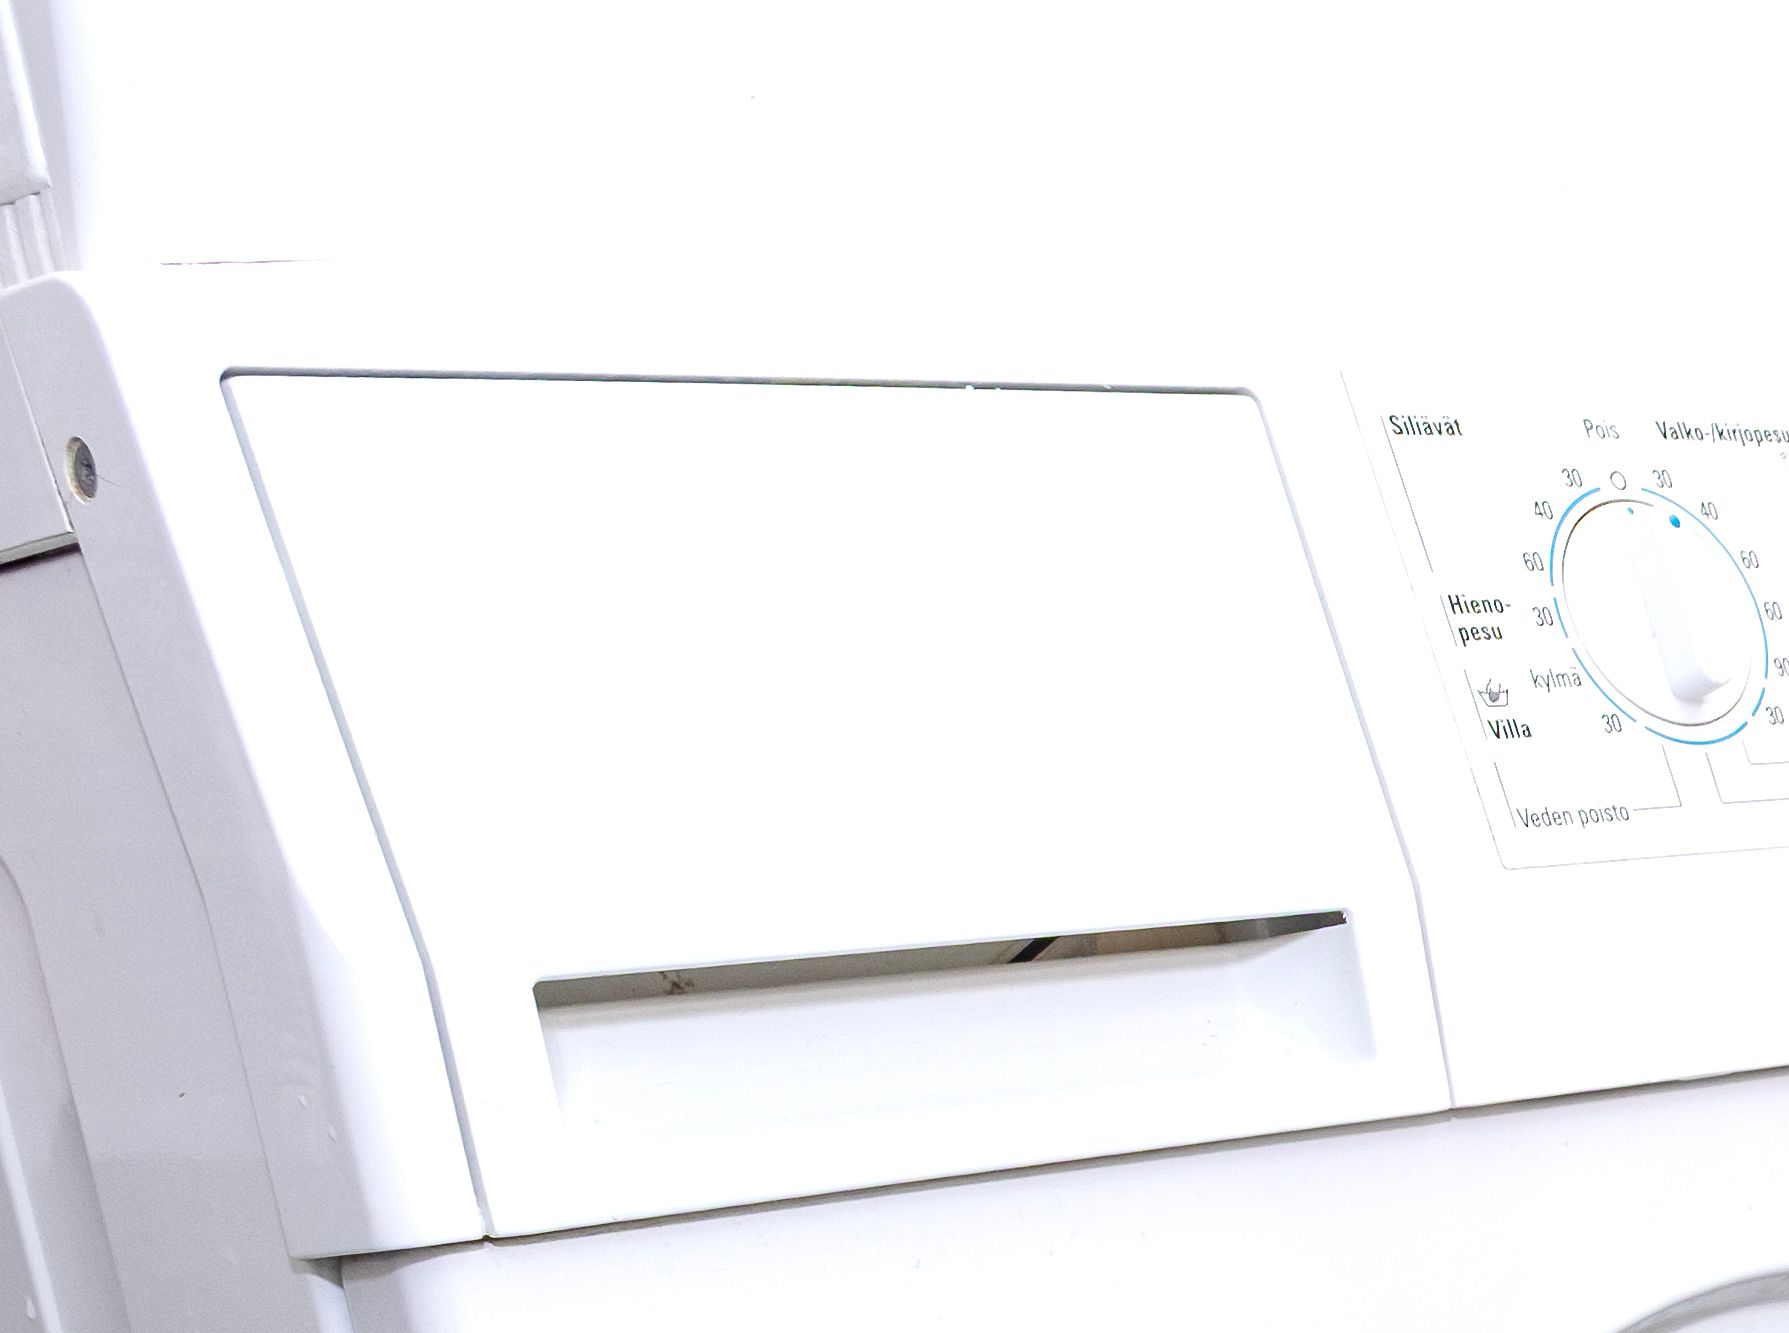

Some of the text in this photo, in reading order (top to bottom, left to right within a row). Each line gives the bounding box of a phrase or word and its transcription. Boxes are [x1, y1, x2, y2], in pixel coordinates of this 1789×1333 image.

[1388, 414, 1463, 437] Siliävät
[1582, 418, 1620, 440] Pois
[1561, 467, 1583, 488] 30
[1651, 469, 1673, 489] 30
[1534, 500, 1554, 521] 40
[1700, 501, 1719, 522] 40
[1522, 551, 1545, 572] 60
[1739, 549, 1760, 571] 60
[1447, 593, 1511, 615] Hieno-
[1763, 601, 1783, 622] 60
[1531, 606, 1555, 627] 30
[1457, 626, 1503, 648] pesu
[1529, 666, 1583, 694] kylmä
[1601, 713, 1623, 734] 30
[1765, 705, 1785, 726] 30
[1486, 718, 1533, 740] Villa
[1515, 804, 1630, 829] Veden poisto
